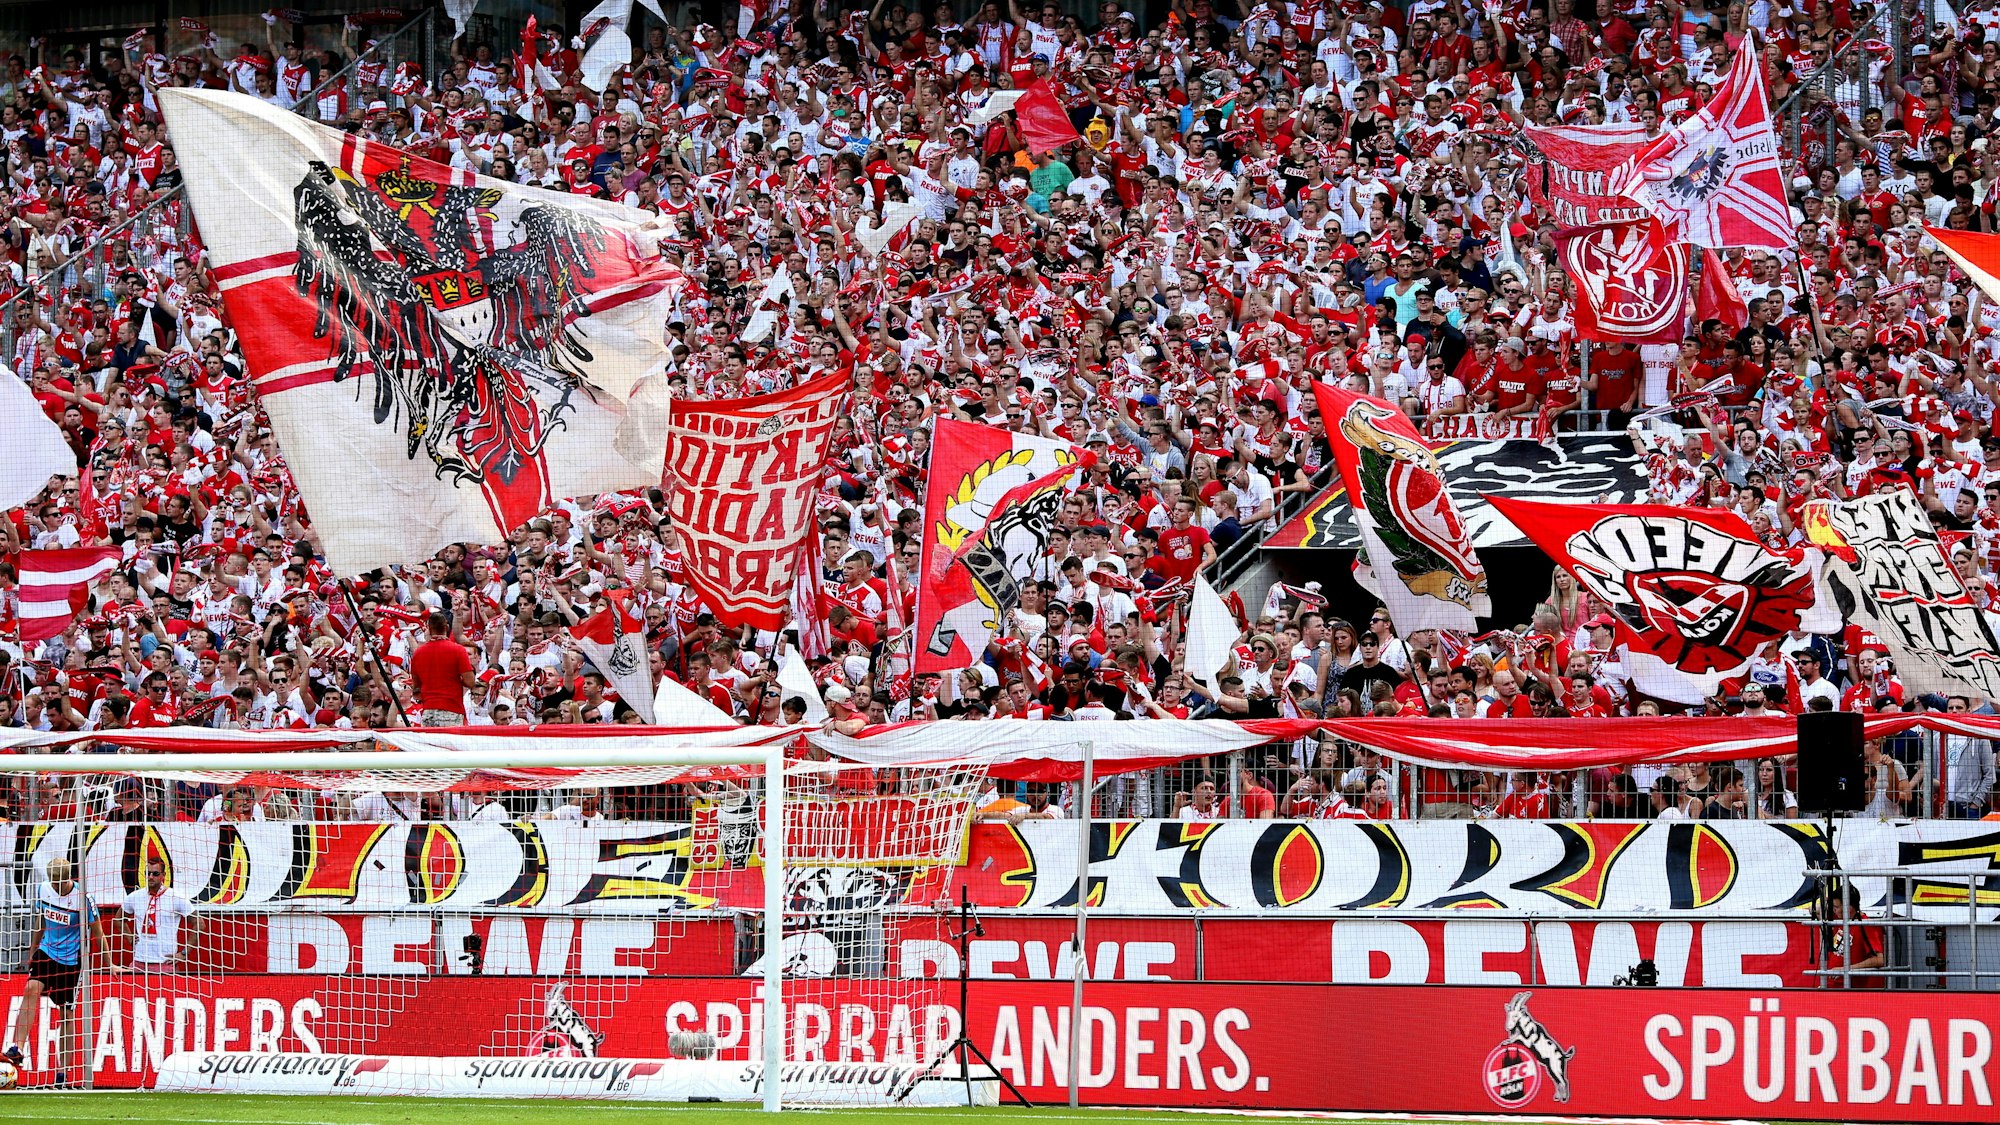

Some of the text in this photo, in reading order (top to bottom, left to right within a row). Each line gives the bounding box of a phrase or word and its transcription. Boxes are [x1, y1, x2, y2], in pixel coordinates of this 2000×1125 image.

[1036, 35, 1055, 43] REWE
[1322, 48, 1343, 56] REWE
[1010, 64, 1031, 72] REWE
[1793, 60, 1815, 70] REWE
[1839, 100, 1861, 108] REWE
[1181, 164, 1205, 177] REWE
[920, 180, 943, 194] REWE
[911, 355, 936, 368] RWE
[1499, 380, 1525, 391] CHAOTIX
[854, 533, 879, 545] REWE
[1756, 672, 1774, 682] Ford
[68, 688, 88, 700] EWE
[692, 803, 719, 864] SEK
[45, 909, 69, 925] REWE
[991, 1005, 1270, 1092] ANDERS.
[1643, 997, 1994, 1106] SPÜRBAR
[1495, 1063, 1528, 1084] 1.FC
